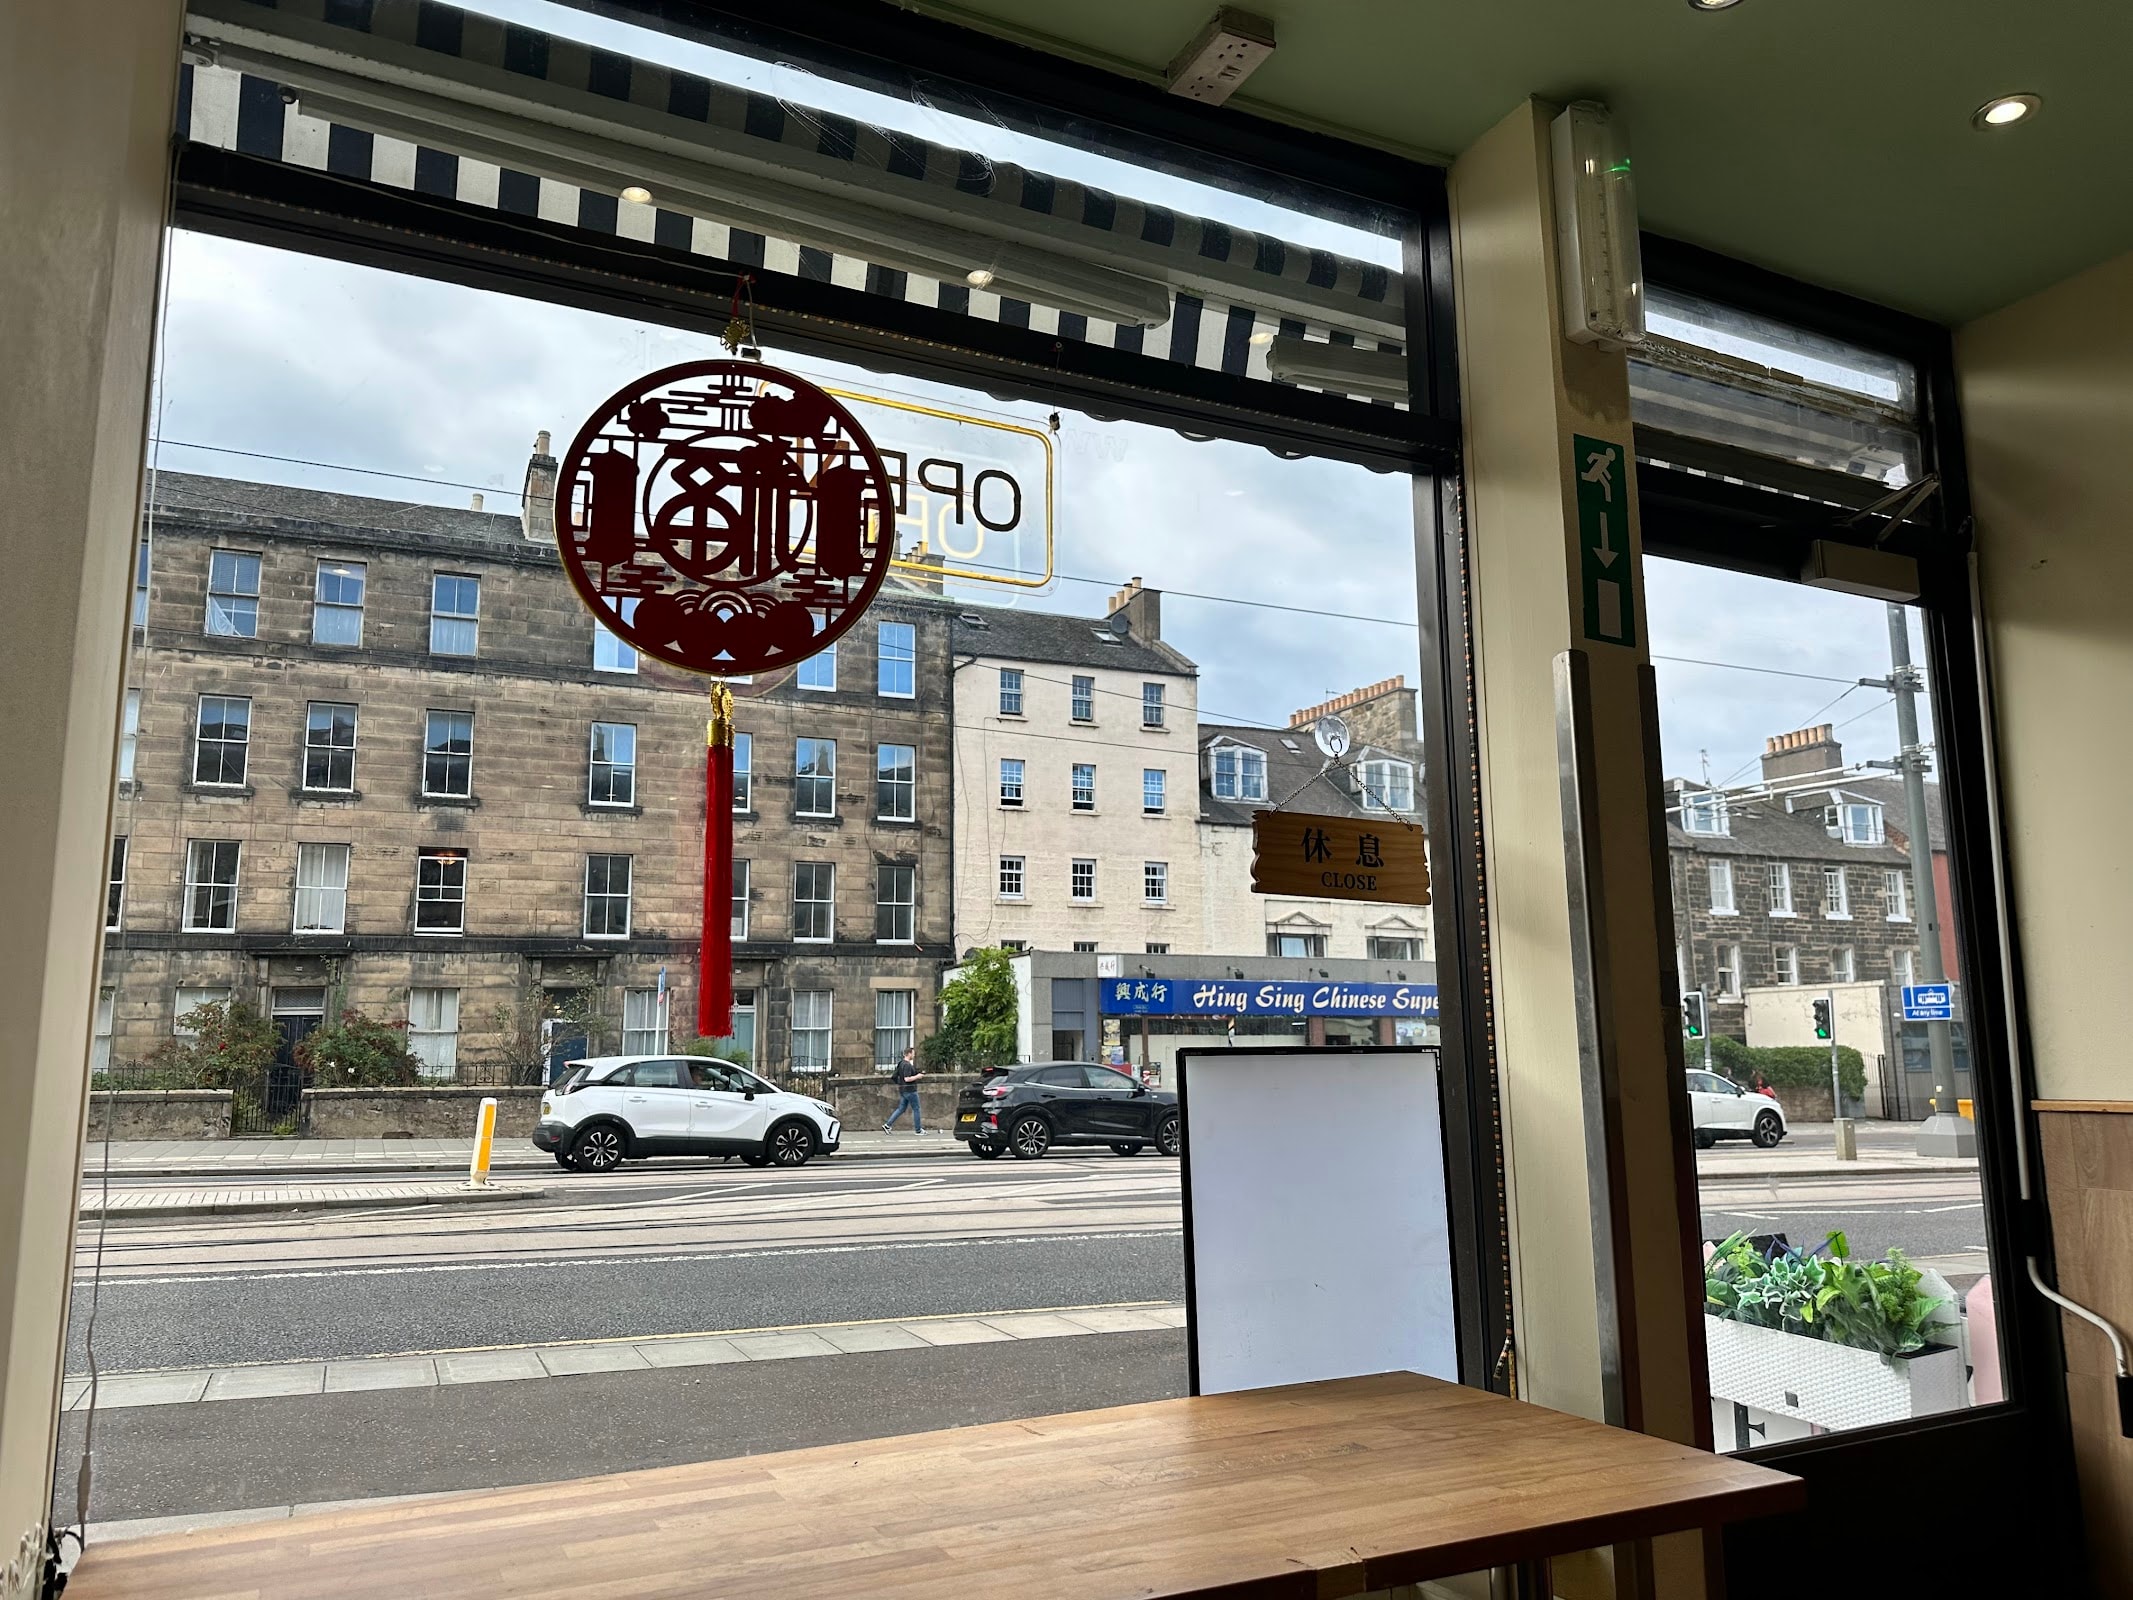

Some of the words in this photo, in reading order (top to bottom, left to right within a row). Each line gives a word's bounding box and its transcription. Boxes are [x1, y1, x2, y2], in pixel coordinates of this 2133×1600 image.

[1301, 828, 1384, 868] 休息
[1321, 872, 1377, 891] CLOSE
[1193, 984, 1248, 1012] Hing
[1255, 985, 1305, 1013] Sing
[1312, 986, 1387, 1009] Chinese
